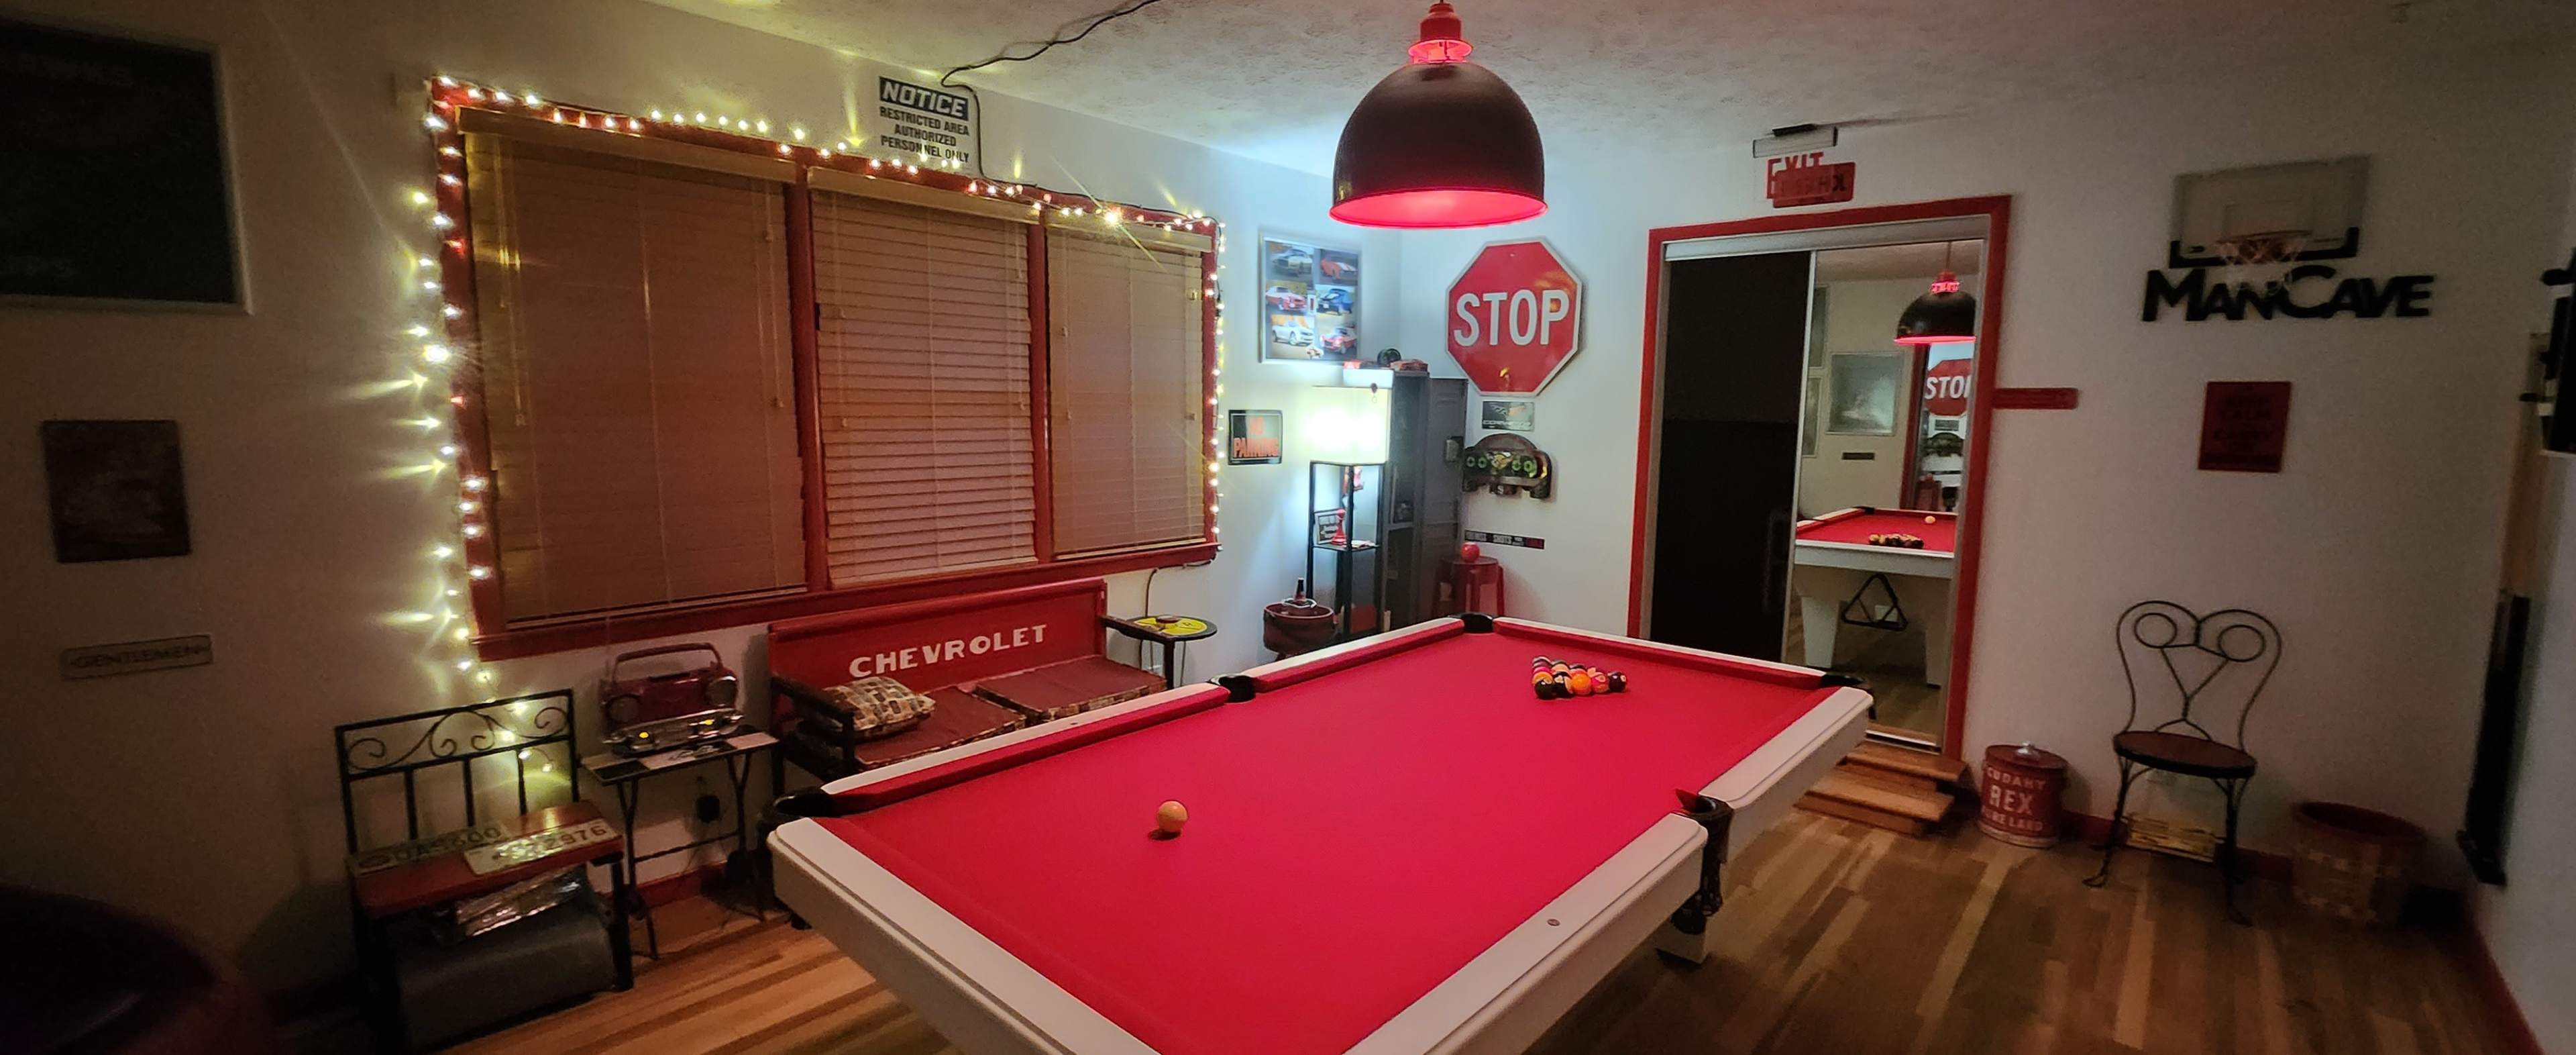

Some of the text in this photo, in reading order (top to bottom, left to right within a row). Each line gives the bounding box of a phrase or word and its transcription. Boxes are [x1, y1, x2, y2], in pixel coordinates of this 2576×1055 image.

[882, 81, 966, 117] NOTICE
[879, 107, 970, 136] RESTRICTED AREA
[894, 124, 956, 146] AUTHORIZED
[881, 135, 969, 163] PERSONNEL ONLY
[1454, 289, 1570, 346] STOP
[850, 624, 1046, 678] CHEVROLET
[1988, 785, 2033, 815] REX
